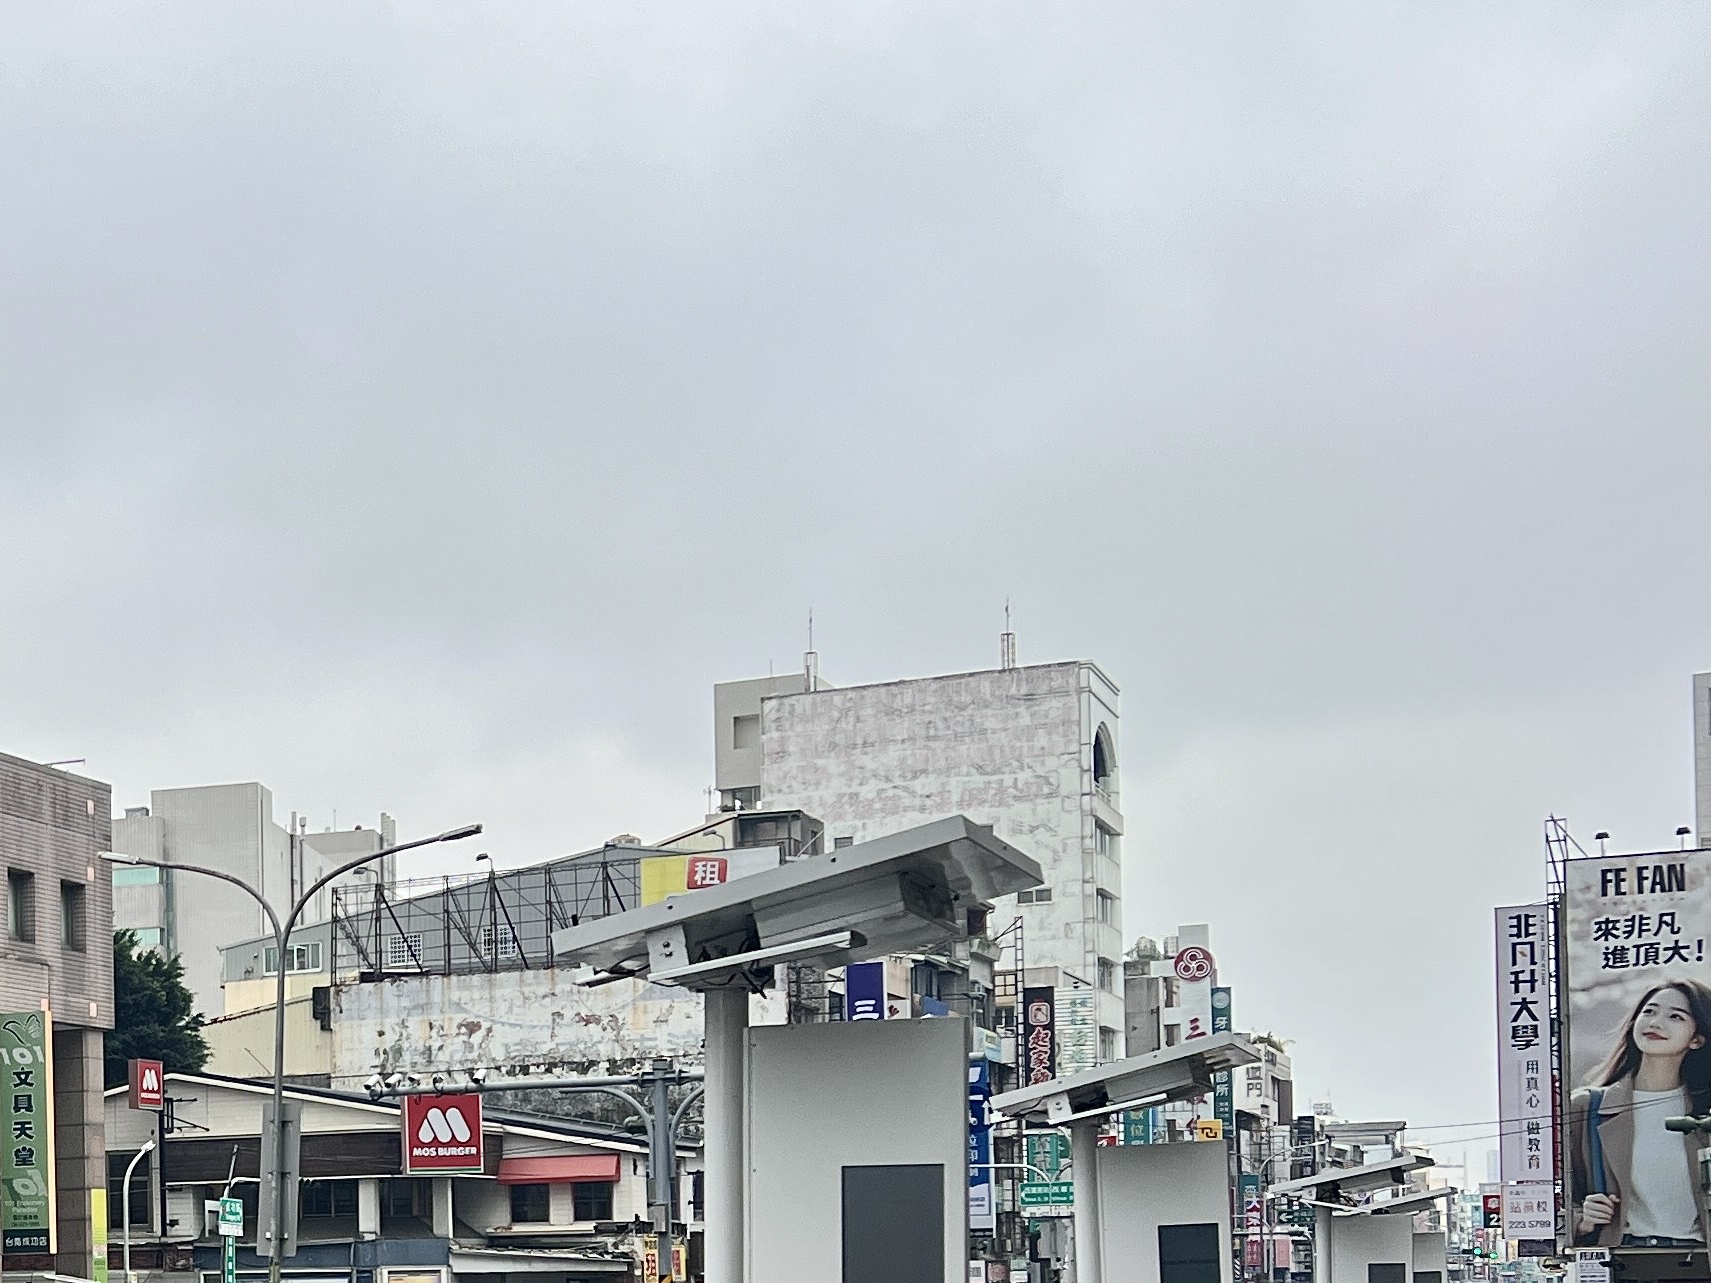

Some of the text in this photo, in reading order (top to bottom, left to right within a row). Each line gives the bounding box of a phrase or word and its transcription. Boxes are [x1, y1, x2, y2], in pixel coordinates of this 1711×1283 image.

[694, 861, 720, 885] 租
[1593, 912, 1681, 941] 來非凡
[1508, 913, 1540, 1051] 非凡升大學
[0, 1046, 44, 1065] 101
[12, 1067, 35, 1167] 文具天堂
[412, 1146, 478, 1157] MOS BURGER
